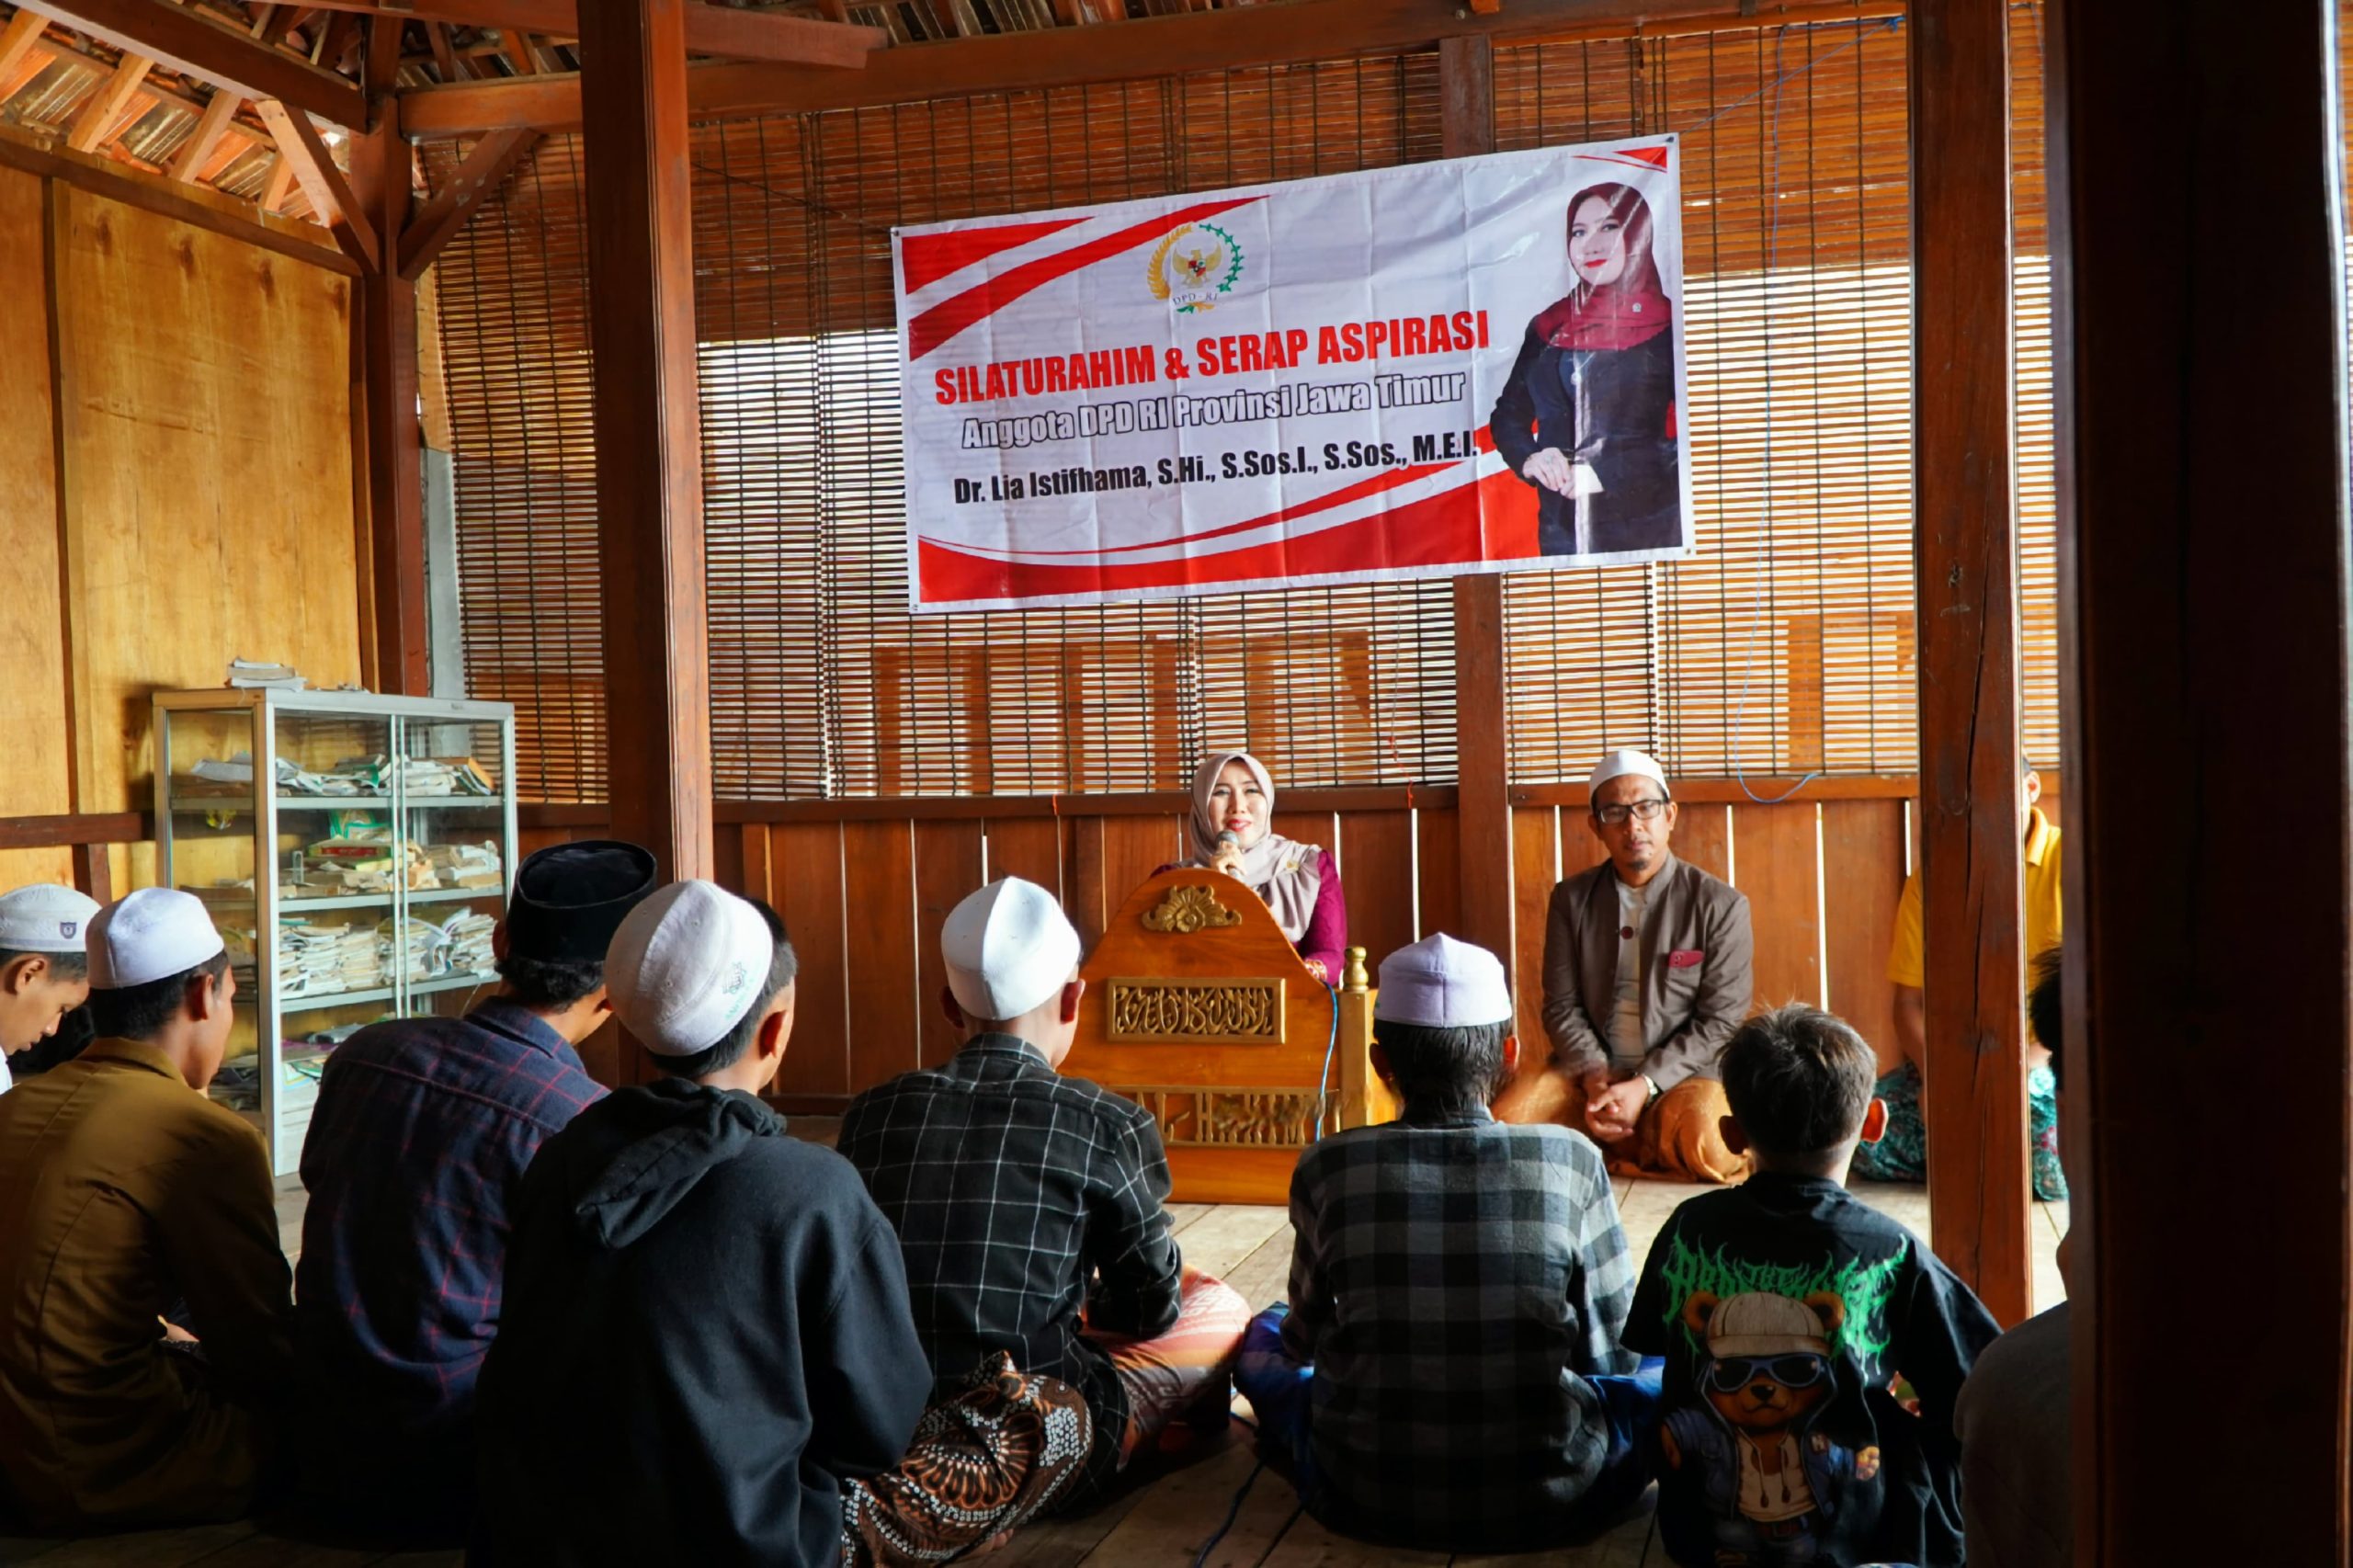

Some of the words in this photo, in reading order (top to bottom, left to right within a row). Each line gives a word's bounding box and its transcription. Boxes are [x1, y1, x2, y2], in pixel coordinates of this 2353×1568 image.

[1173, 292, 1196, 305] DPD
[935, 345, 1155, 405] SILATURAHIM
[1164, 347, 1189, 381] &
[1197, 328, 1308, 377] SERAP
[1317, 310, 1489, 365] ASPIRASI
[961, 411, 1075, 449] Anggota
[1078, 401, 1134, 437] DPD
[1138, 397, 1168, 431] RI
[1172, 385, 1290, 428] Provinsi
[1296, 382, 1371, 415] Jawa
[1374, 372, 1466, 409] Timur
[954, 478, 985, 504] Dr.
[991, 474, 1024, 501] Lia
[1029, 465, 1153, 497] Istifhama,
[1157, 456, 1216, 485] S.Hi.,
[1221, 446, 1318, 480] S.Sos.I.,
[1324, 440, 1407, 471] S.Sos.,
[1413, 430, 1478, 462] M.E.I.
